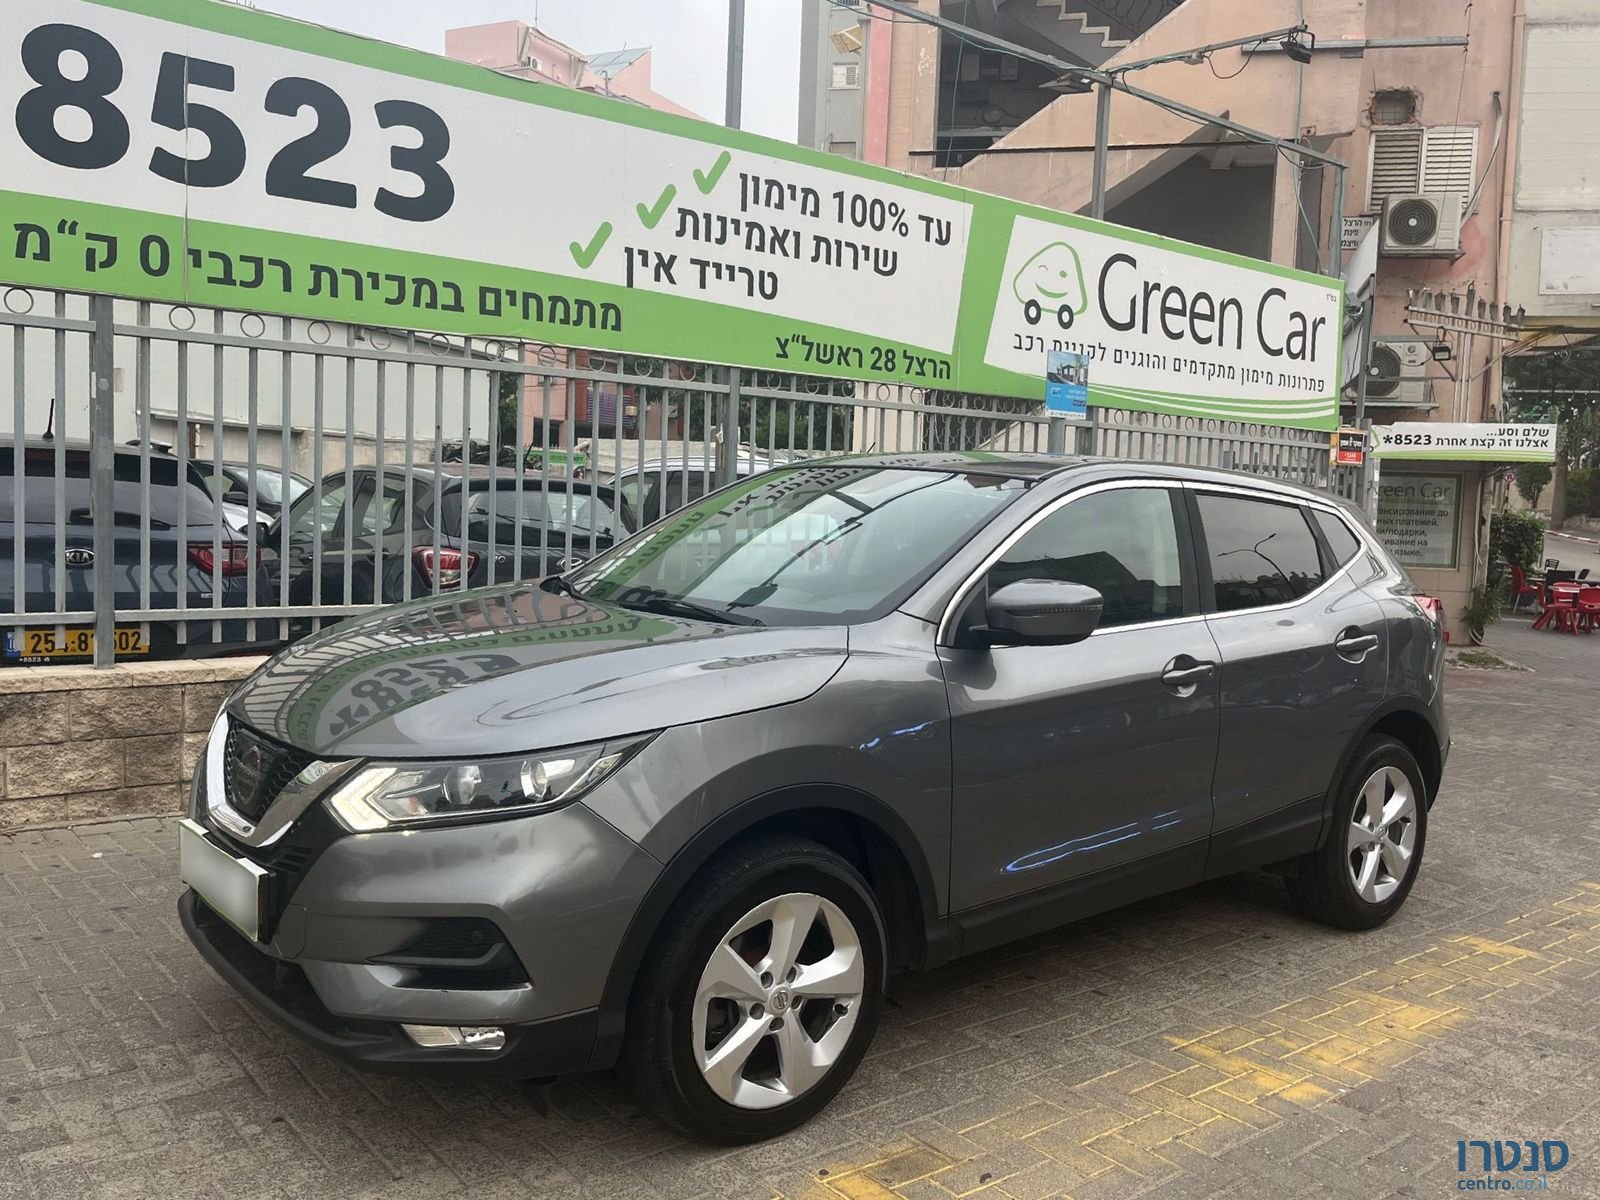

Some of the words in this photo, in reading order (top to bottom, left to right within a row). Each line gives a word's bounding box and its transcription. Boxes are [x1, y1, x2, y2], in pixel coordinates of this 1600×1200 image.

[15, 23, 455, 223] 8523
[739, 172, 820, 218] מימון
[832, 190, 909, 237] 100%
[675, 207, 801, 260] ואמינות
[918, 214, 952, 246] עד
[139, 234, 170, 278] 0
[187, 247, 292, 293] רכבי
[624, 246, 678, 289] אין
[810, 234, 898, 277] שירות
[307, 263, 465, 313] במכירת
[690, 257, 778, 300] טרייד
[478, 285, 622, 332] מתמחים
[1098, 252, 1243, 350] Green
[1256, 287, 1326, 362] Car
[1013, 332, 1045, 354] רכב
[870, 346, 896, 373] 28
[903, 348, 951, 380] הרצל
[1113, 348, 1168, 372] והוגנים
[1173, 356, 1236, 382] מתקדמים
[1241, 366, 1274, 386] מימון
[1278, 371, 1326, 393] פתרונות
[1435, 437, 1468, 447] אחרת
[1470, 438, 1496, 449] קצת
[1499, 438, 1512, 447] זה
[1516, 437, 1549, 449] אצלנו
[1522, 426, 1550, 437] שלם
[1377, 484, 1415, 498] reen
[1420, 482, 1451, 499] Car
[66, 552, 91, 562] KIA
